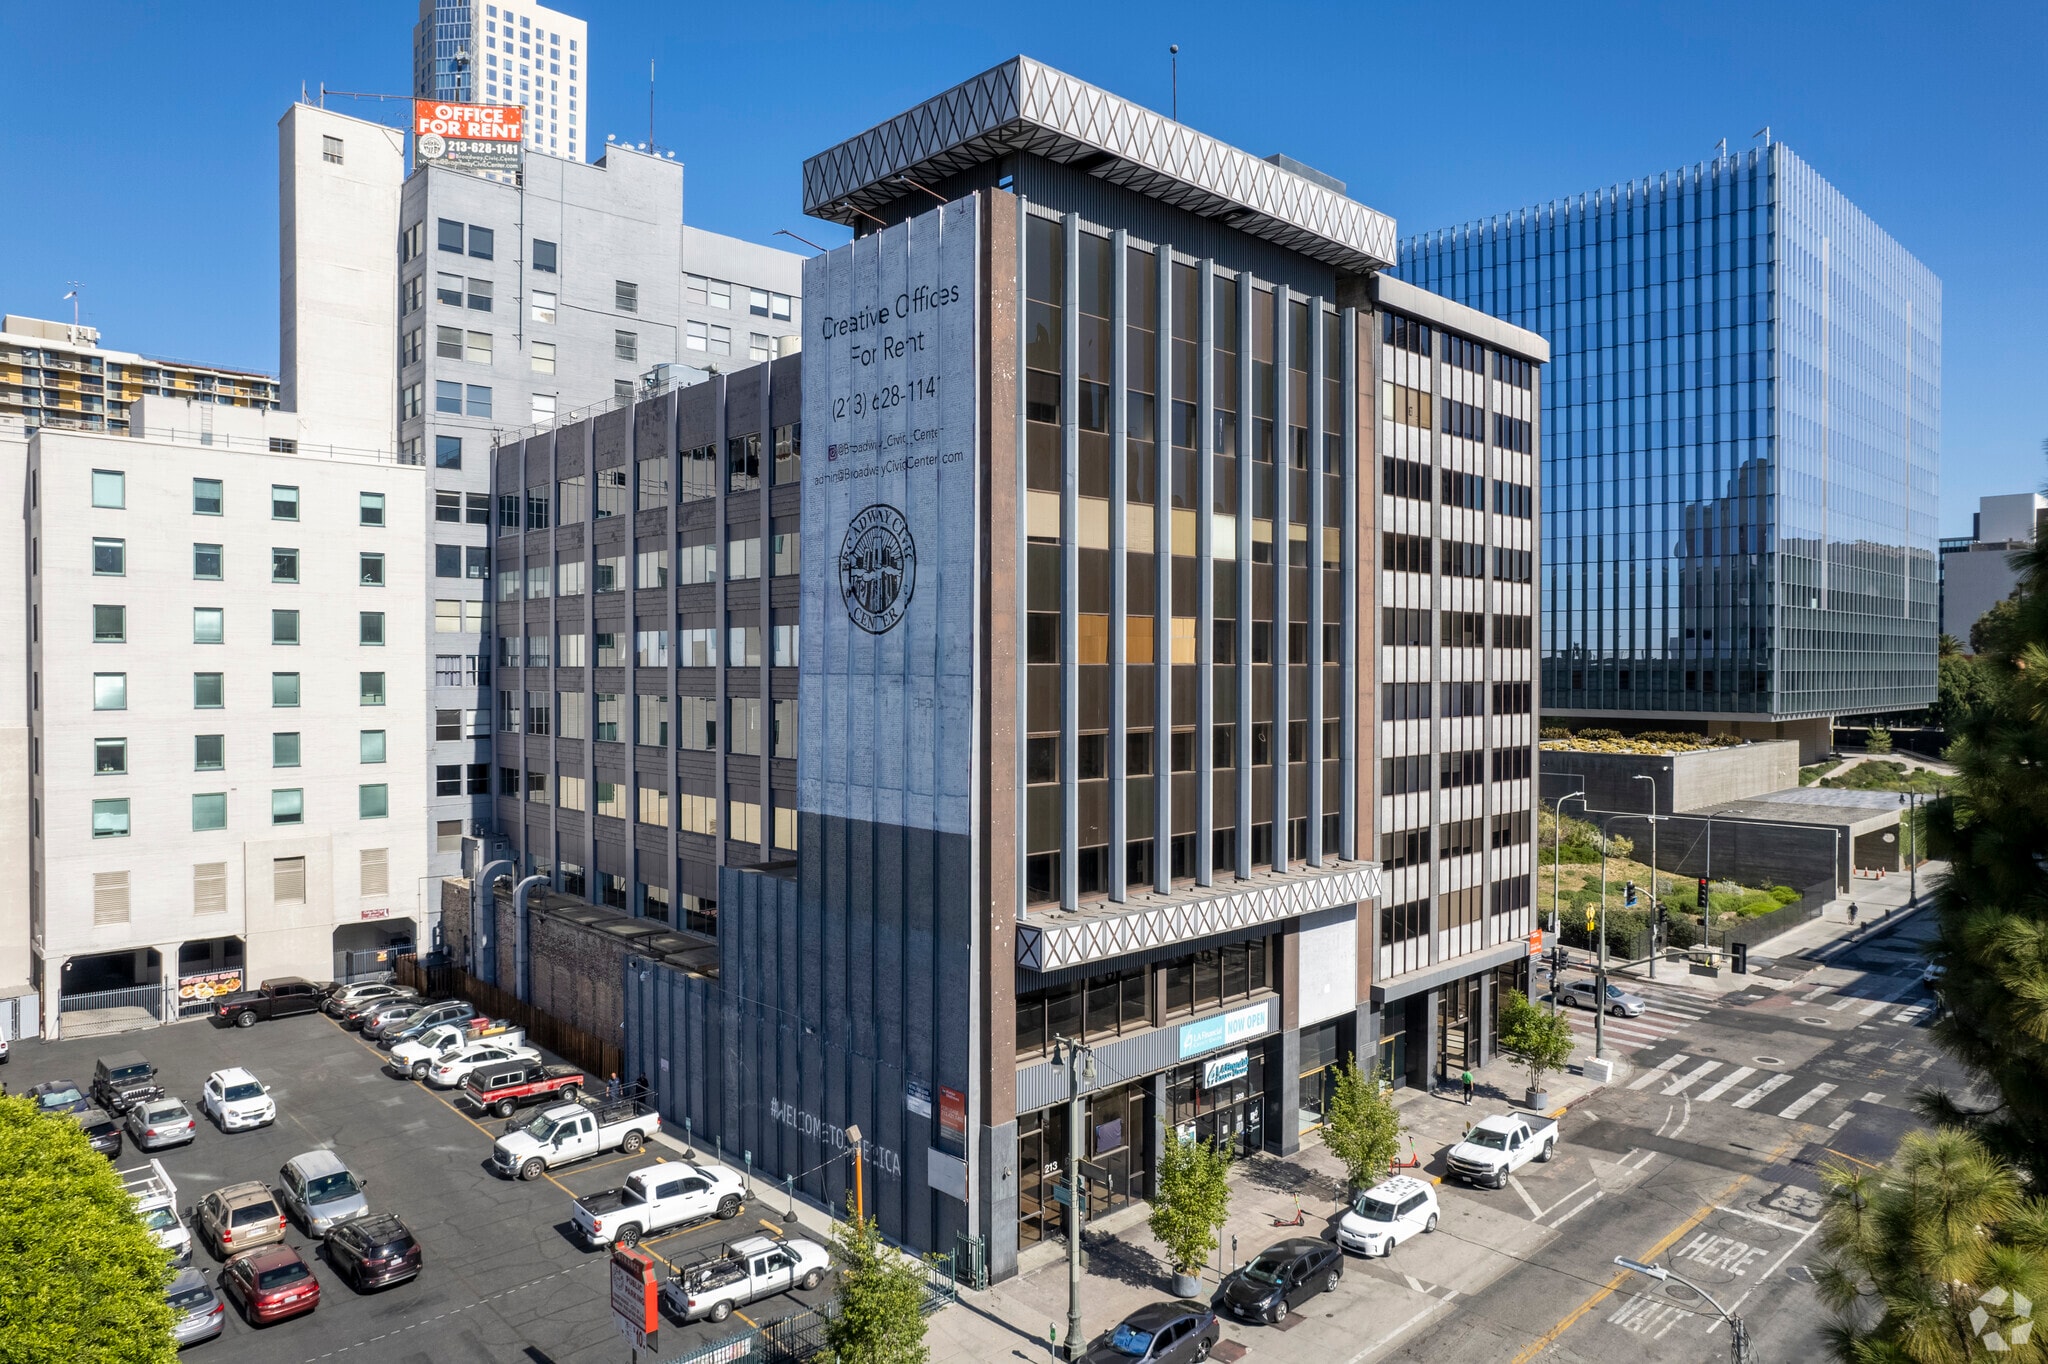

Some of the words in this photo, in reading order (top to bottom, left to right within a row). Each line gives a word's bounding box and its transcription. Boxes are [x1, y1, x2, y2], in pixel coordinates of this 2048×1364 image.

[419, 118, 460, 135] FOR
[467, 121, 519, 138] RENT
[435, 105, 503, 123] OFFICE
[448, 141, 518, 154] 213-628-1141
[822, 305, 889, 340] Creative
[895, 285, 959, 318] Offices
[851, 345, 877, 366] For
[884, 331, 924, 360] Rent
[832, 392, 867, 422] (213)
[872, 376, 941, 410] 628-114
[814, 450, 964, 485] admin@BroadwayCivicCentercom
[1227, 1017, 1245, 1035] NOW
[1246, 1011, 1265, 1029] OPEN
[770, 1097, 901, 1175] #WELCOMETOEICA
[1044, 1161, 1058, 1174] 213
[1676, 1232, 1770, 1276] HERE
[624, 1285, 645, 1306] PARKING
[626, 1275, 643, 1293] PUBLIC
[1607, 1292, 1694, 1340] WAIT
